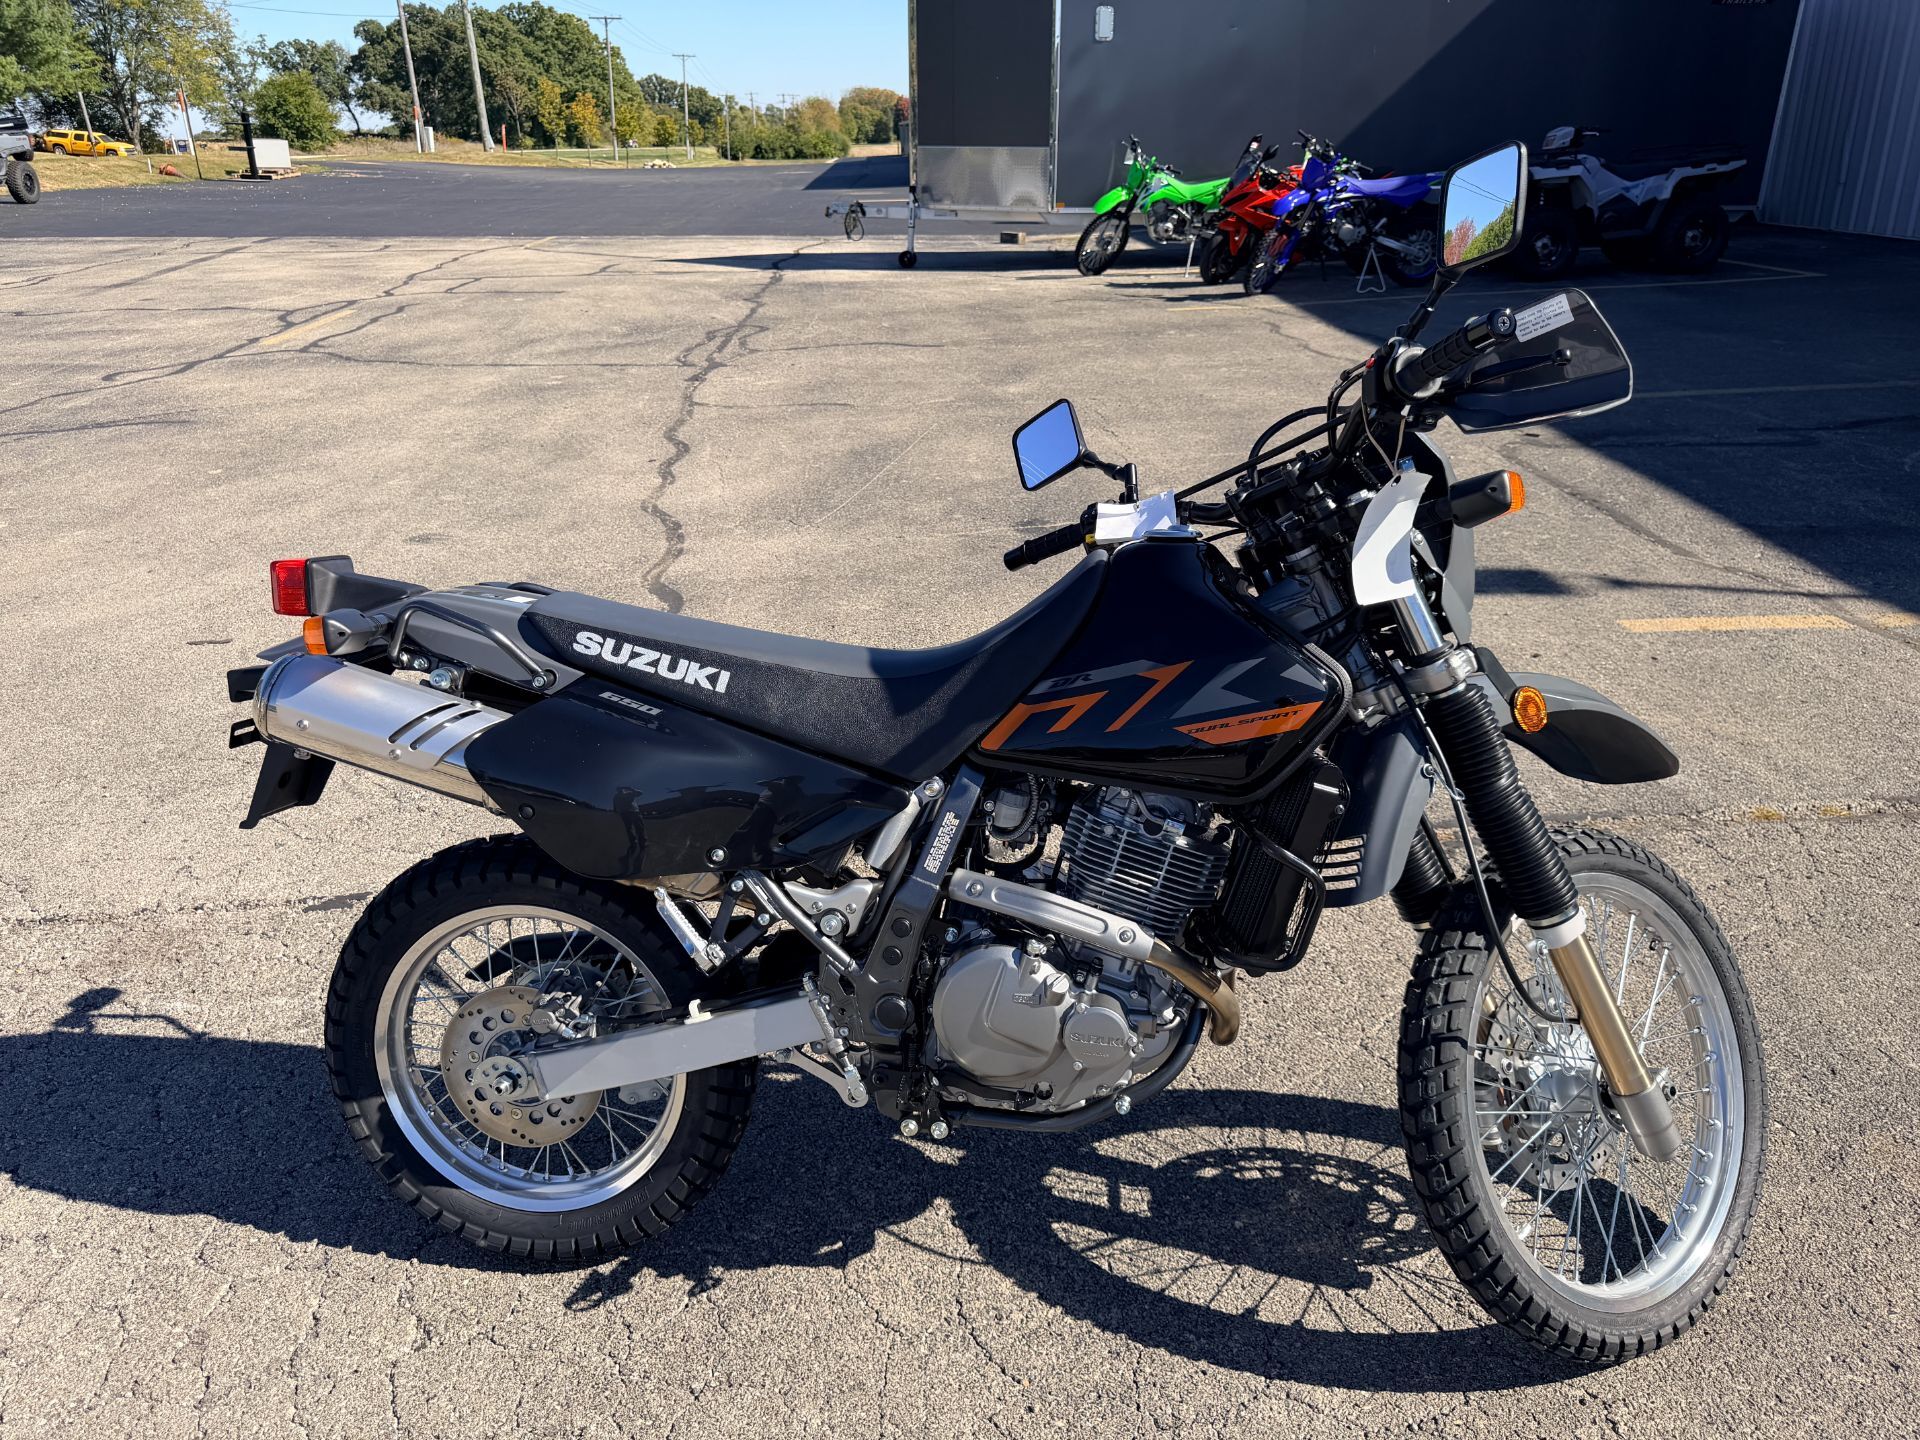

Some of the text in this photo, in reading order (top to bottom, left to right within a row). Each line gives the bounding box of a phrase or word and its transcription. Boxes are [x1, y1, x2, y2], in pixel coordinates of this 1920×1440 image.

[572, 631, 731, 694] SUZUKI
[1048, 673, 1094, 690] DR
[598, 691, 664, 716] 650
[1070, 1033, 1124, 1048] SUZUKI
